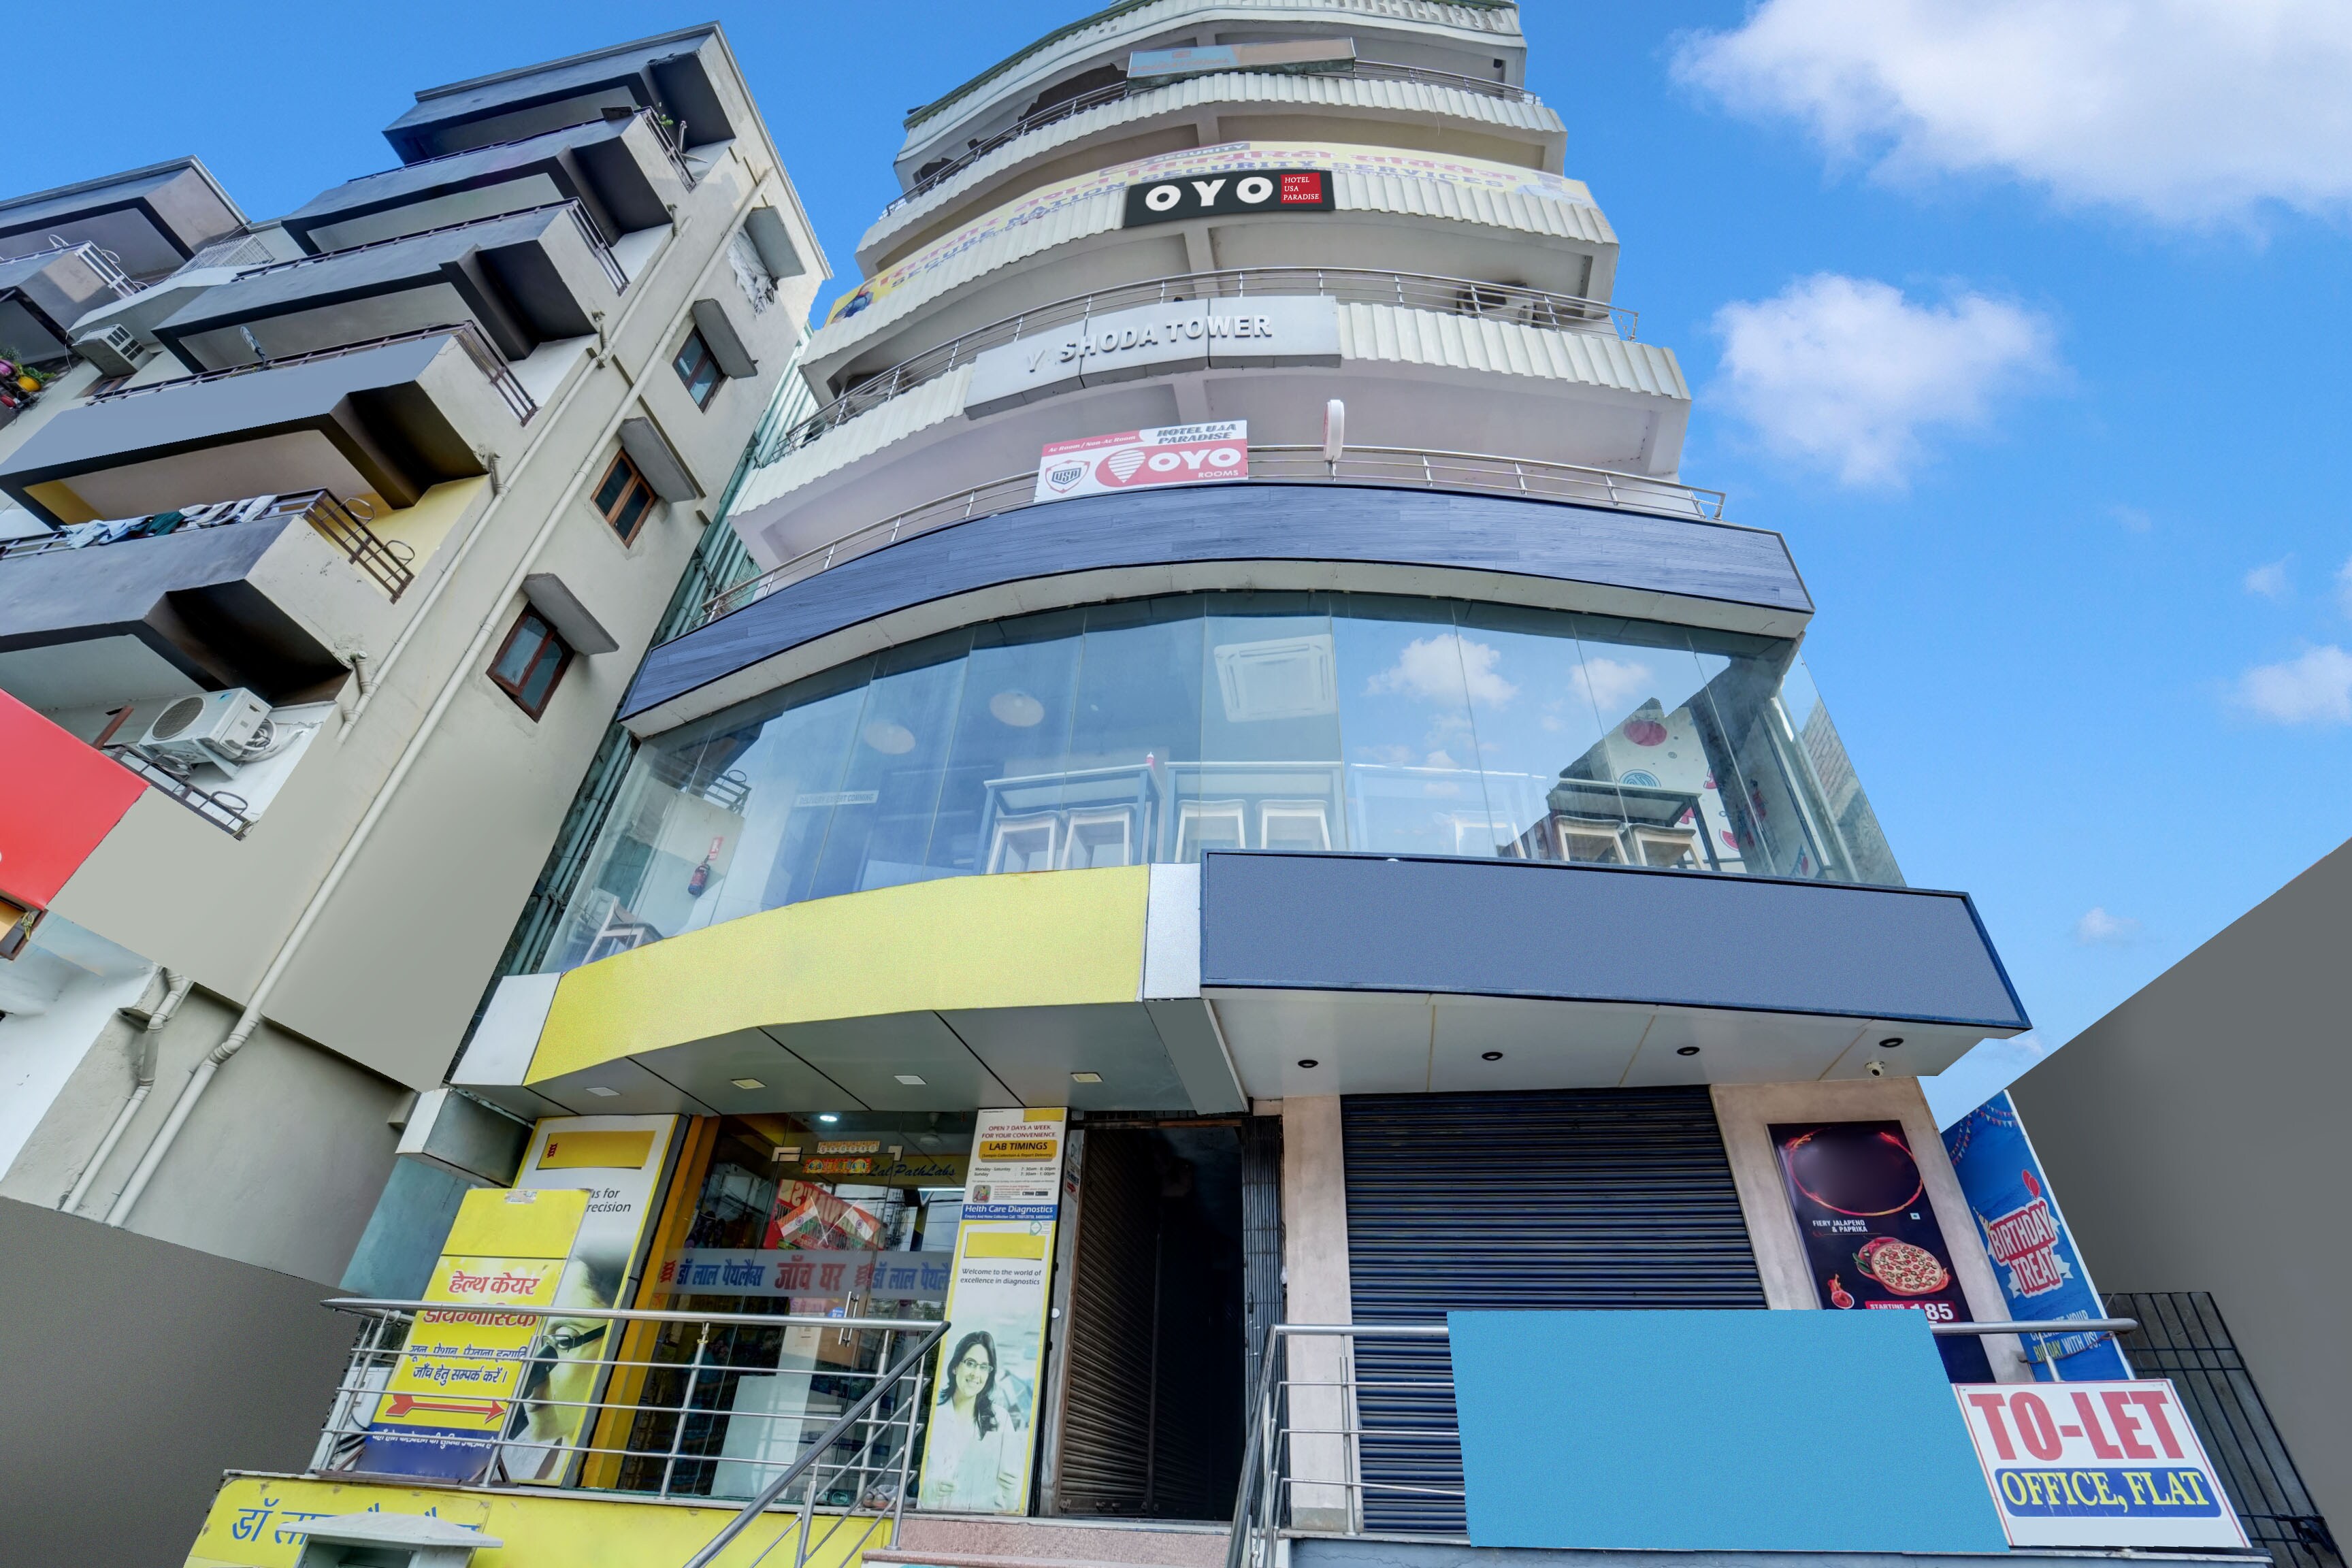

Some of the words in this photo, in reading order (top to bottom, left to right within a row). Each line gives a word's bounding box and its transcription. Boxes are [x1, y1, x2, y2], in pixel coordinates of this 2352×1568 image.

[1145, 177, 1273, 211] OYO
[891, 227, 995, 288] SECURE
[1007, 181, 1127, 225] NATION
[1140, 161, 1316, 182] SECURITY
[1332, 162, 1505, 187] SERVICES
[1026, 323, 1158, 373] YSHODA
[1166, 315, 1273, 342] TOWER
[1059, 444, 1080, 452] Room
[1114, 435, 1136, 443] Room
[1157, 427, 1205, 437] HOTEL
[1158, 431, 1232, 444] PARADISE
[1148, 447, 1241, 472] OYO
[1054, 469, 1081, 483] USA
[1198, 470, 1239, 478] ROOMS
[1009, 1142, 1048, 1150] TIMINGS
[894, 1164, 956, 1177] PathLabs
[603, 1188, 621, 1198] for
[586, 1201, 631, 1212] recision
[1008, 1205, 1053, 1215] Diagnostics
[1989, 1206, 2054, 1260] BIRTHDAY
[692, 1264, 721, 1285] लाल
[774, 1255, 817, 1290] जाँच
[819, 1262, 846, 1291] घर
[888, 1268, 917, 1290] लाल
[2012, 1247, 2059, 1290] TREAT
[448, 1271, 490, 1293] हेल्थ
[491, 1272, 540, 1294] केयर
[2047, 1340, 2063, 1359] DAY
[2061, 1333, 2085, 1354] WITH
[413, 1362, 434, 1378] जाँच
[434, 1364, 451, 1386] हेतु
[451, 1365, 485, 1381] सम्पर्क
[1967, 1390, 2185, 1461] TO-LET
[2001, 1471, 2128, 1513] OFFICE,
[2122, 1471, 2210, 1505] FLAT
[232, 1498, 279, 1542] डॉ
